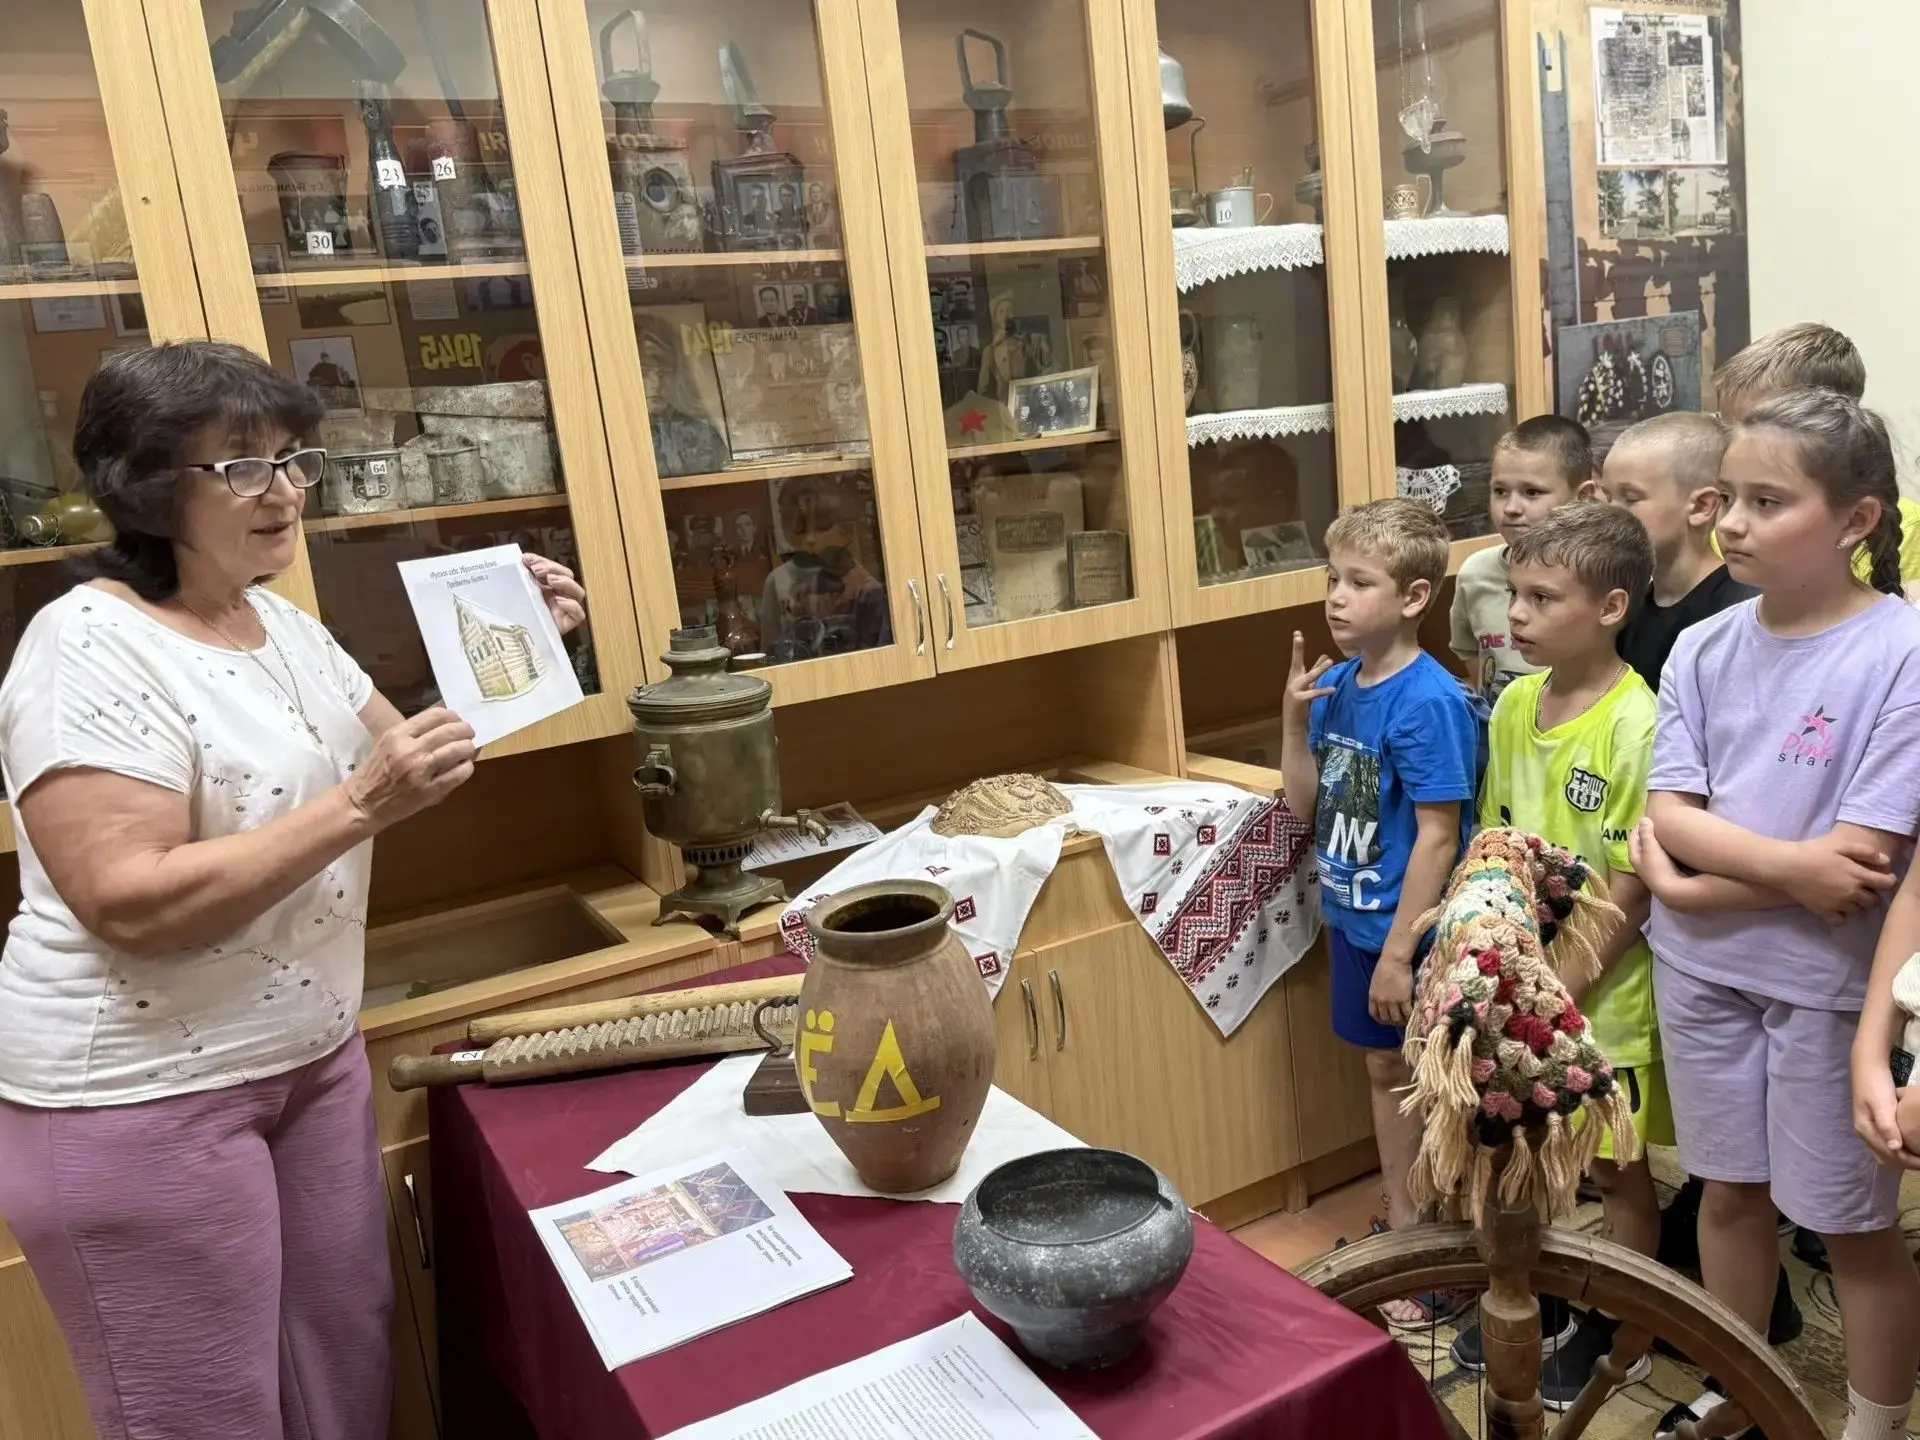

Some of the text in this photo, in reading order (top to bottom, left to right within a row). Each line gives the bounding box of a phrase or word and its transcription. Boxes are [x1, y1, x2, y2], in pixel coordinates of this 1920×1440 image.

[381, 168, 400, 182] 23
[436, 162, 452, 177] 26
[1220, 208, 1232, 221] 10
[311, 234, 330, 249] 30
[373, 464, 386, 474] 64
[1781, 731, 1834, 759] Pink
[1778, 752, 1832, 768] star
[1602, 828, 1631, 841] AM
